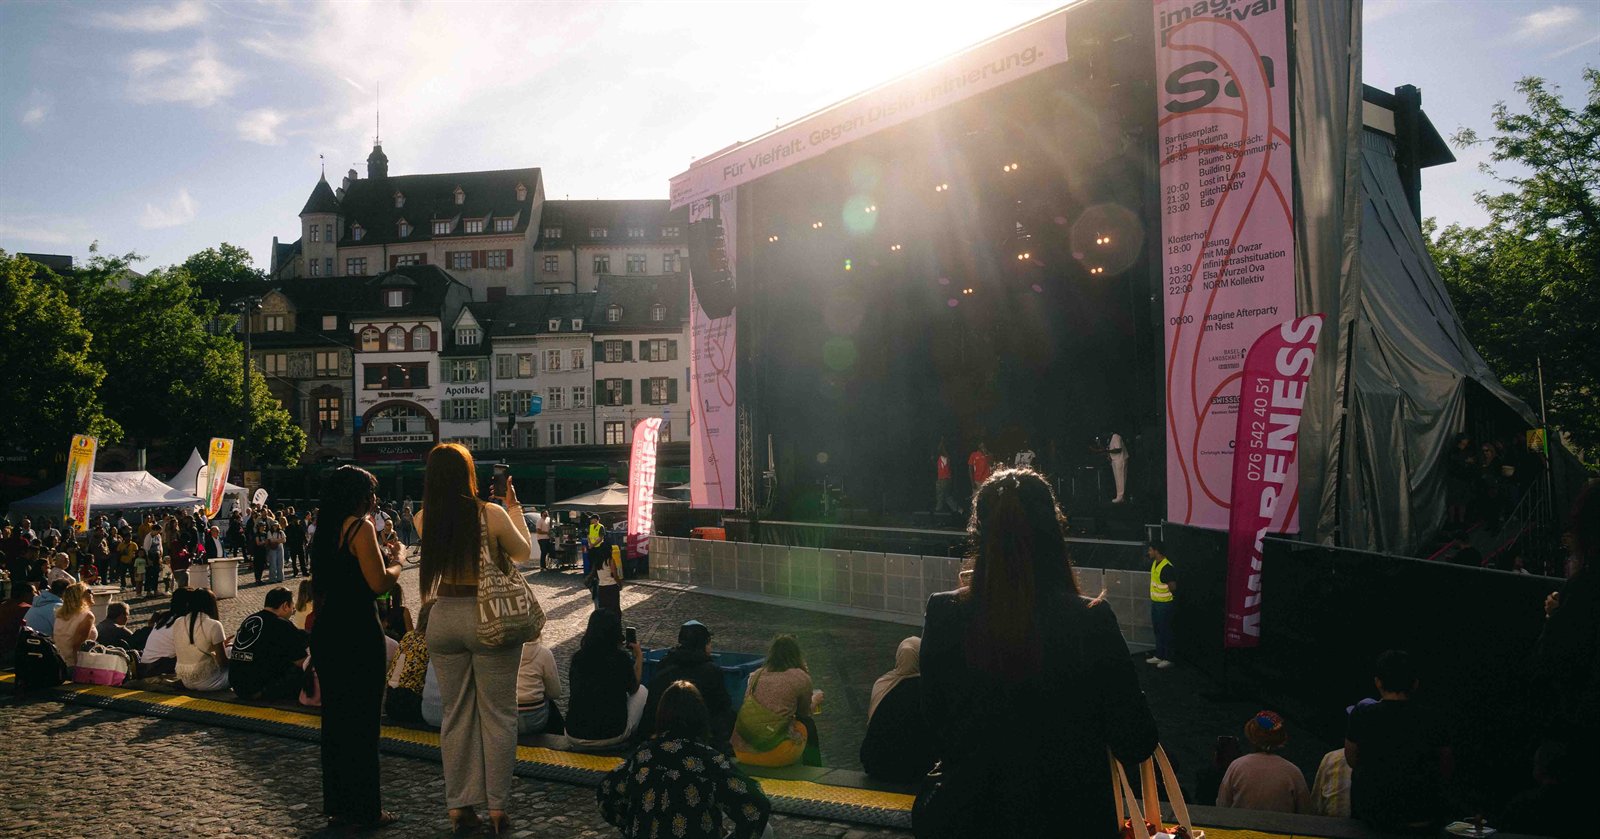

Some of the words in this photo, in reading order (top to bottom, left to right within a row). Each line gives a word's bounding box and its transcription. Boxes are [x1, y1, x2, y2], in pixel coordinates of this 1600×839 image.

[1165, 124, 1219, 145] Barfüsserplatz
[722, 162, 746, 181] Für
[748, 138, 806, 170] Vielfalt.
[809, 116, 864, 146] Gegen
[1199, 164, 1231, 178] Building
[1166, 182, 1189, 194] 20:00
[1200, 176, 1216, 188] Lost
[1216, 174, 1224, 182] in
[1166, 192, 1190, 204] 21:30
[1200, 180, 1245, 198] glitchBABY
[1167, 202, 1190, 214] 23:00
[1200, 198, 1215, 208] Edb
[1168, 230, 1208, 244] Klosterhof
[1168, 243, 1192, 255] 18:00
[1202, 238, 1230, 249] Lesung
[1202, 250, 1214, 259] mit
[1237, 242, 1263, 254] Owzar
[1168, 264, 1192, 275] 19:30
[1202, 250, 1286, 270] infinitetrashsituation
[1168, 274, 1193, 285] 20:30
[1202, 270, 1218, 280] Elsa
[1220, 266, 1248, 278] Wurzel
[1248, 264, 1265, 274] Ova
[1169, 284, 1193, 296] 22:00
[1203, 280, 1228, 290] NORM
[1230, 274, 1265, 287] Kollektiv
[1170, 315, 1194, 326] 00:00
[1236, 306, 1278, 318] Afterparty
[1215, 322, 1234, 331] Nest
[445, 386, 485, 396] Apotheke
[1256, 378, 1270, 394] 51
[1212, 396, 1240, 404] SWISSL
[1254, 398, 1268, 418] 40
[1250, 420, 1266, 449] 542
[1247, 449, 1262, 482] 076
